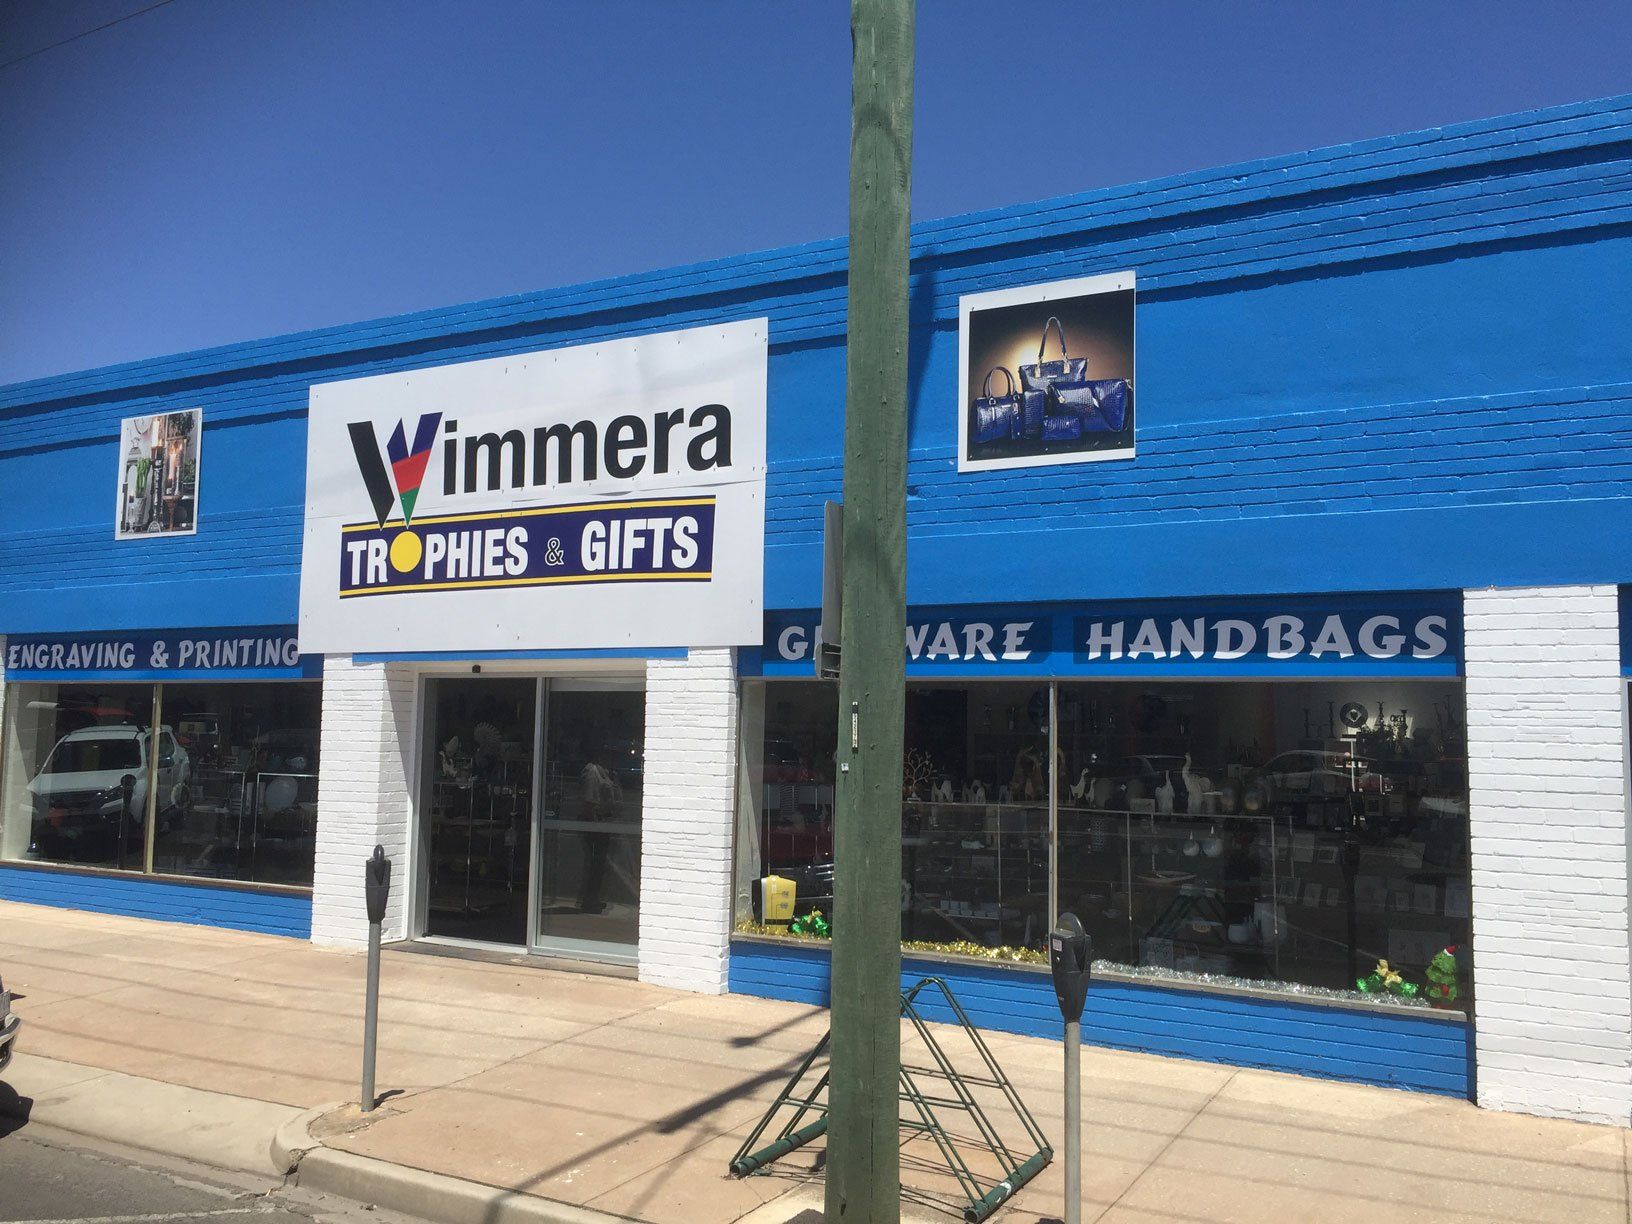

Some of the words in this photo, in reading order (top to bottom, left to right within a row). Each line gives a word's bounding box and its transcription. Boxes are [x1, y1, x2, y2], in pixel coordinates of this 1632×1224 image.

[347, 403, 732, 530] Wimmera
[347, 526, 529, 585] TROPHIES
[544, 537, 565, 566] &
[581, 516, 699, 572] GIFTS
[8, 642, 136, 669] ENGRAVING
[150, 640, 169, 668] &
[178, 638, 299, 668] PRINTING
[1086, 614, 1447, 660] HANDBAGS
